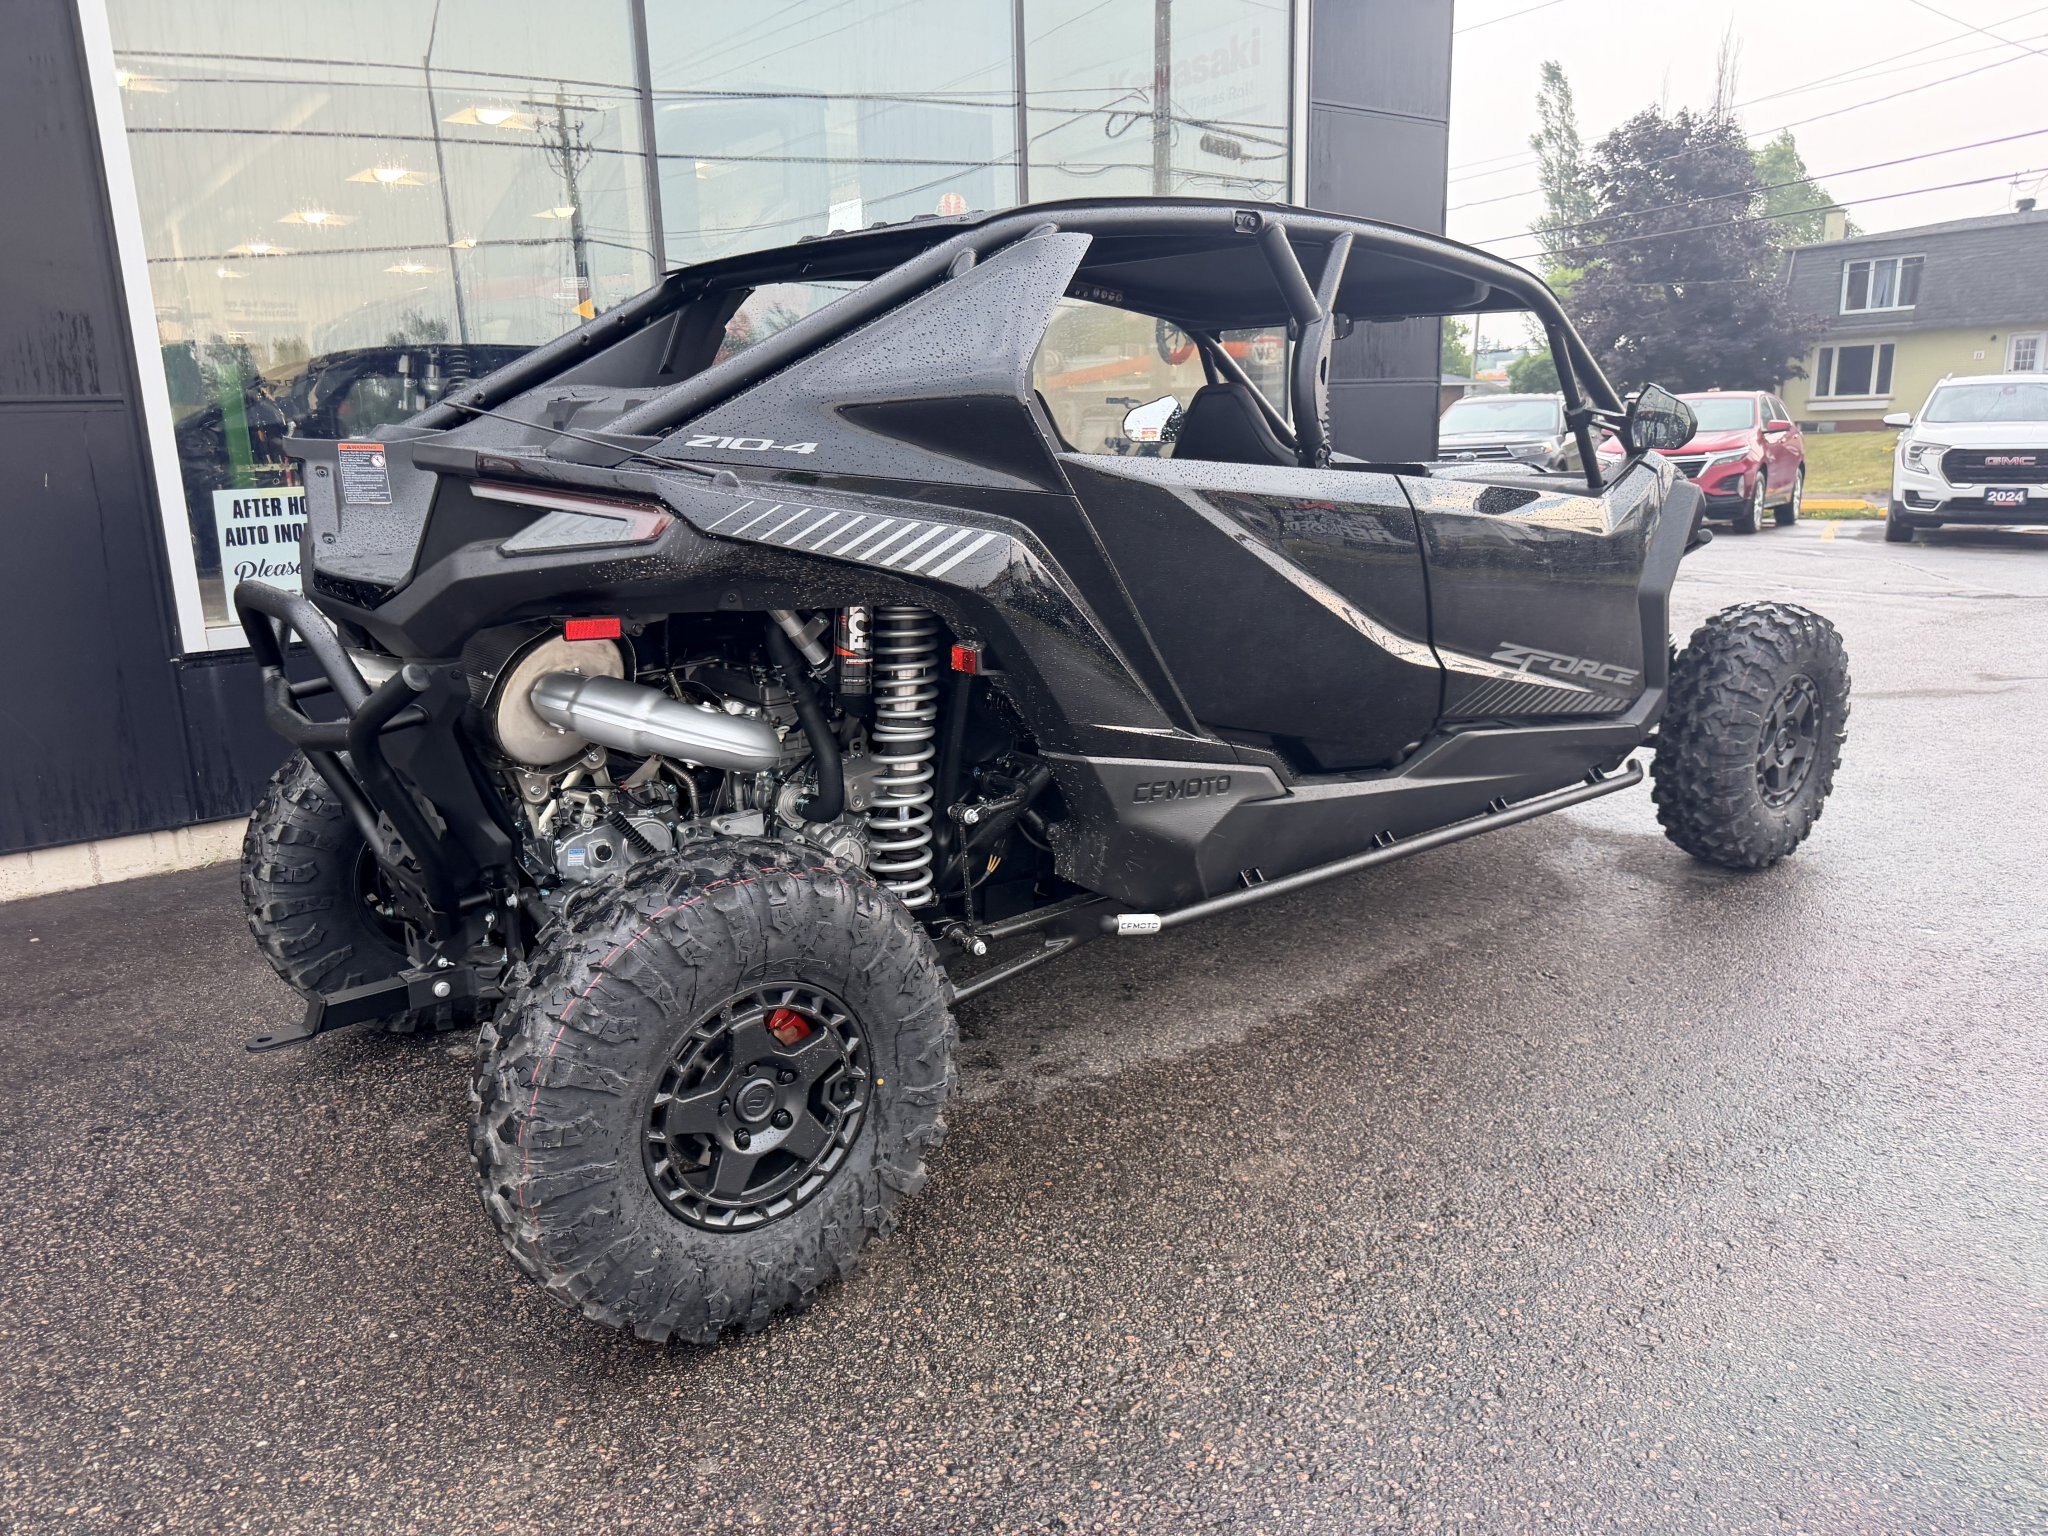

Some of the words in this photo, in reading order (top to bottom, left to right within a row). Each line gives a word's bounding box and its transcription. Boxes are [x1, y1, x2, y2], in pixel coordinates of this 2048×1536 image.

[684, 434, 819, 455] Z10-4
[1984, 456, 2037, 466] GMC
[1986, 490, 2025, 502] 2024
[233, 497, 283, 519] AFTER
[226, 525, 269, 547] AUTO
[274, 523, 307, 543] INQ
[1132, 775, 1231, 804] CFMOTO
[1120, 922, 1159, 930] CFMOTO
